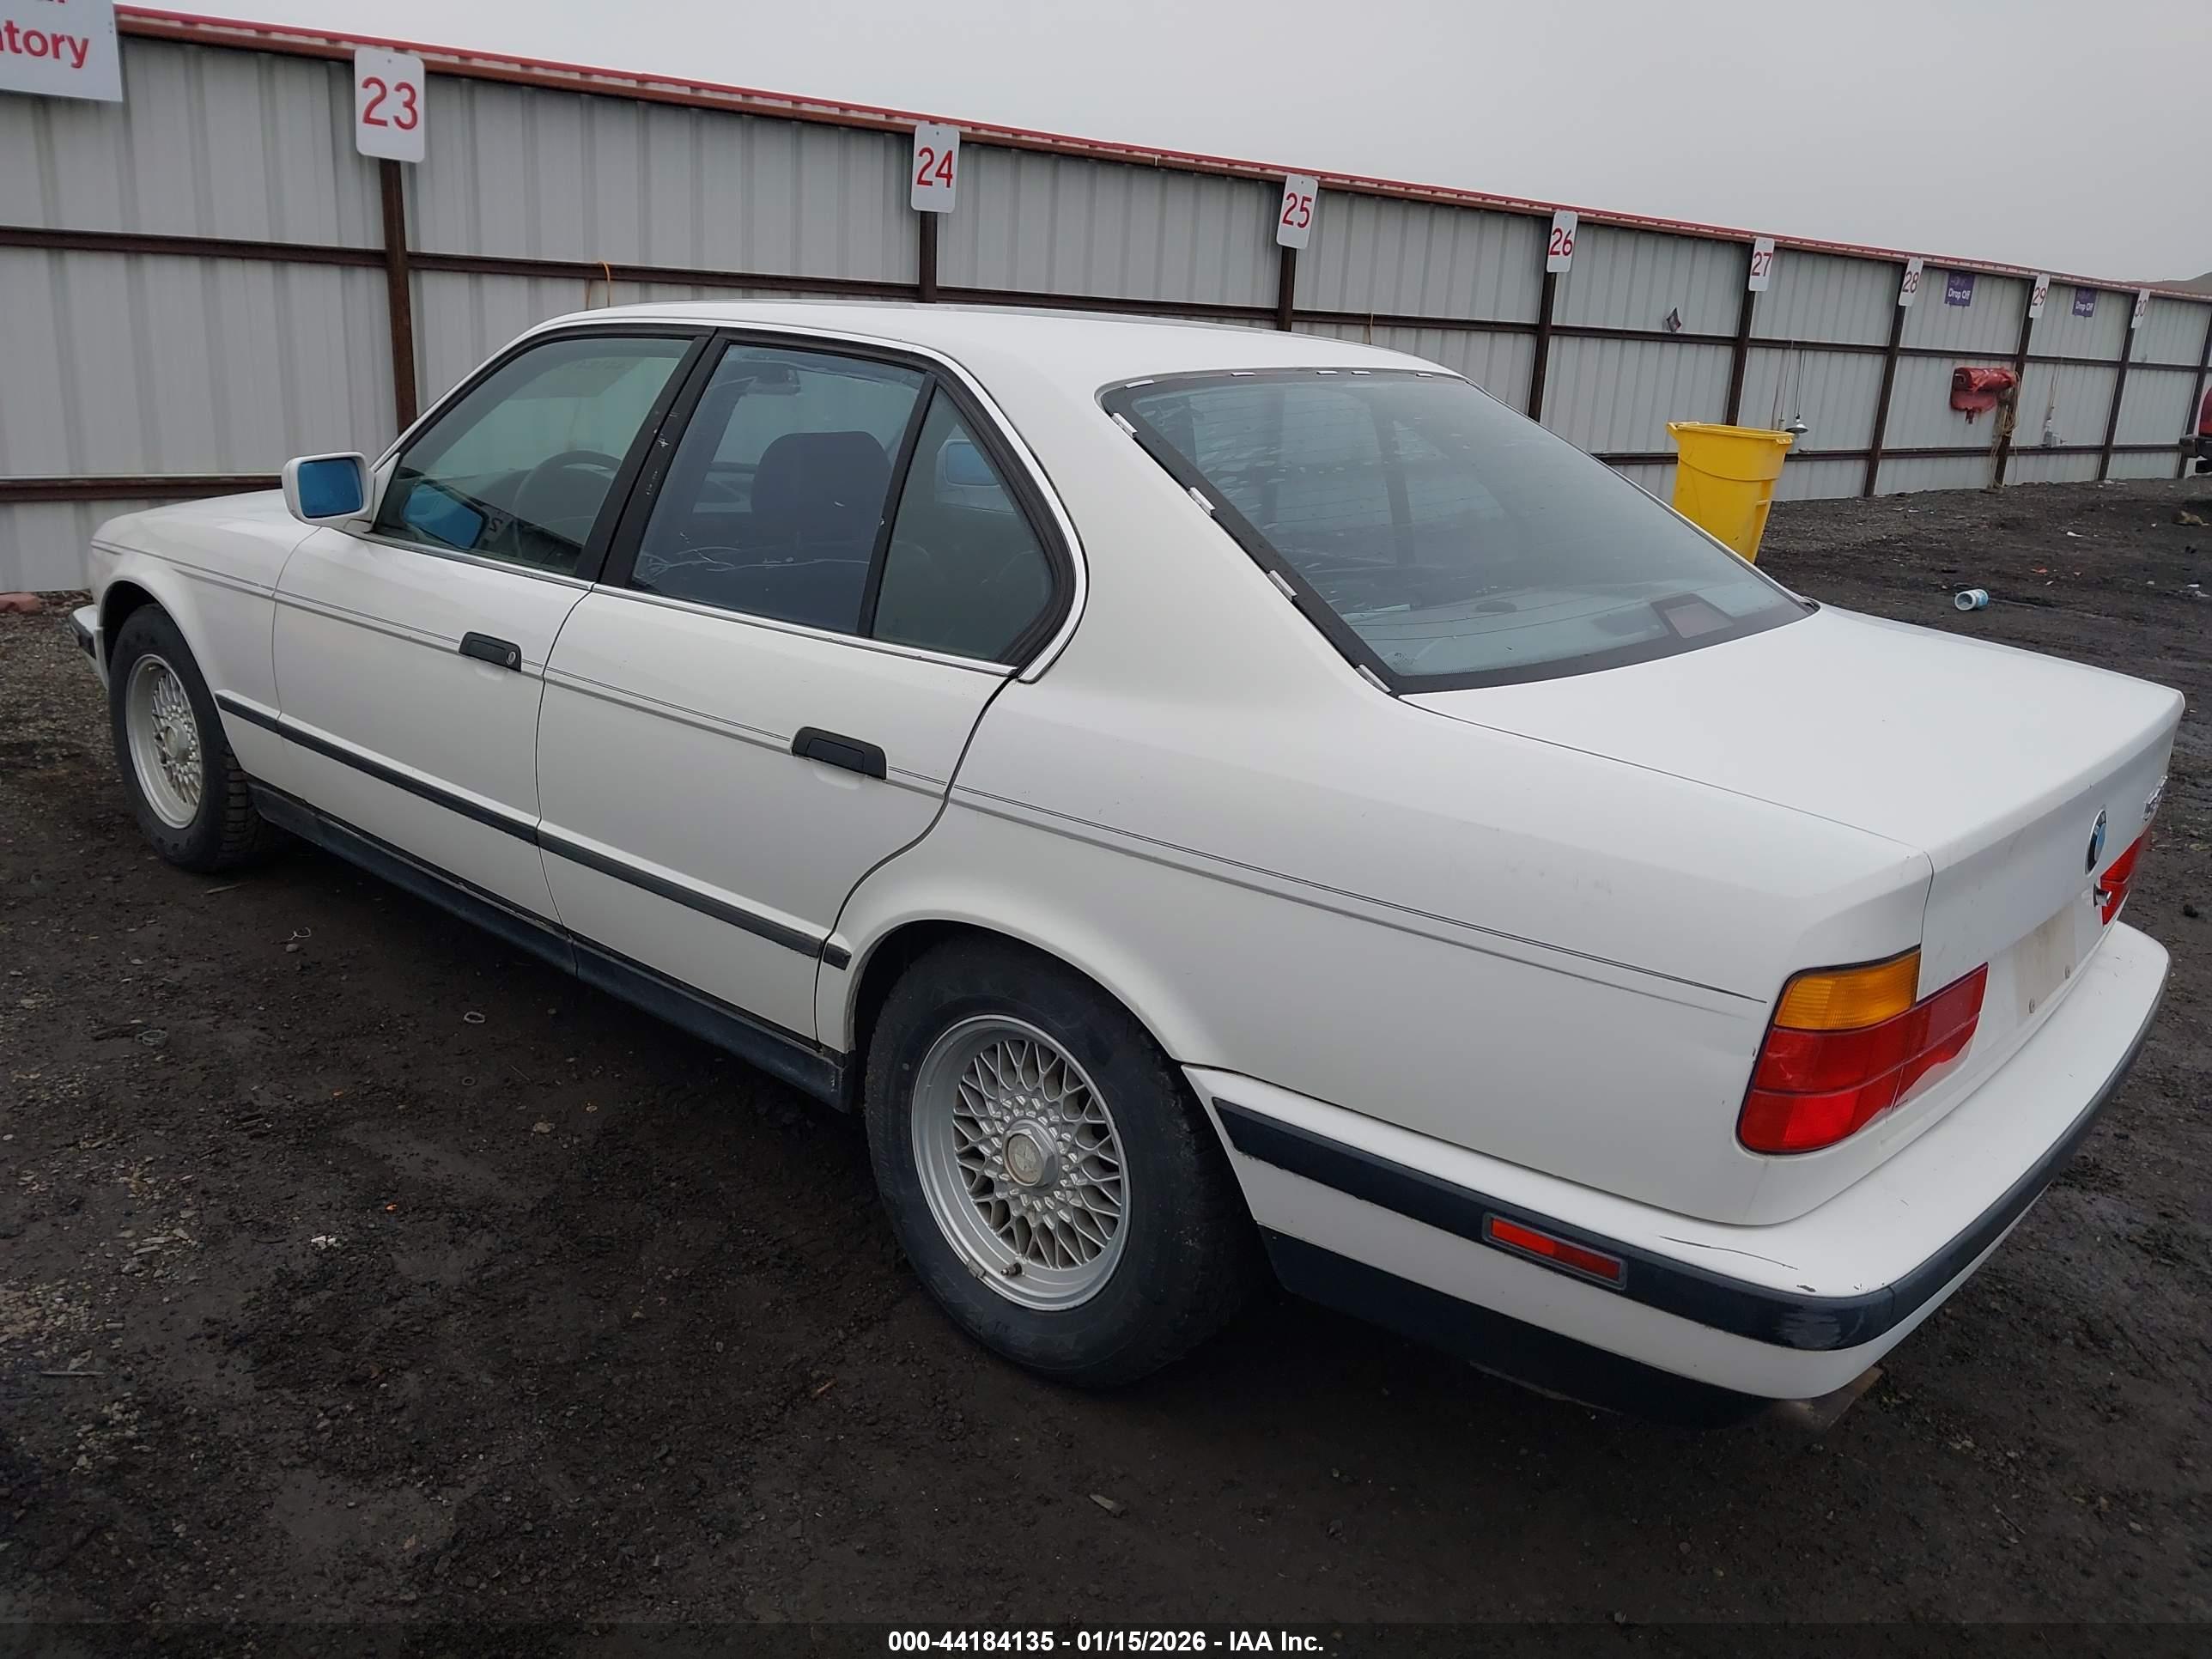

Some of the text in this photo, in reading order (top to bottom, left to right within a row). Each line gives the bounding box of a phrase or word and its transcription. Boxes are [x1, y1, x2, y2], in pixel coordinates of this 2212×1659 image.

[0, 21, 88, 69] tory
[362, 76, 419, 131] 23
[916, 145, 954, 188] 24
[1282, 191, 1313, 228] 25
[1548, 228, 1573, 257] 26
[1751, 252, 1773, 276] 27
[1903, 270, 1919, 294] 28
[1948, 288, 1971, 301] Drop Off
[2033, 288, 2046, 306] 29
